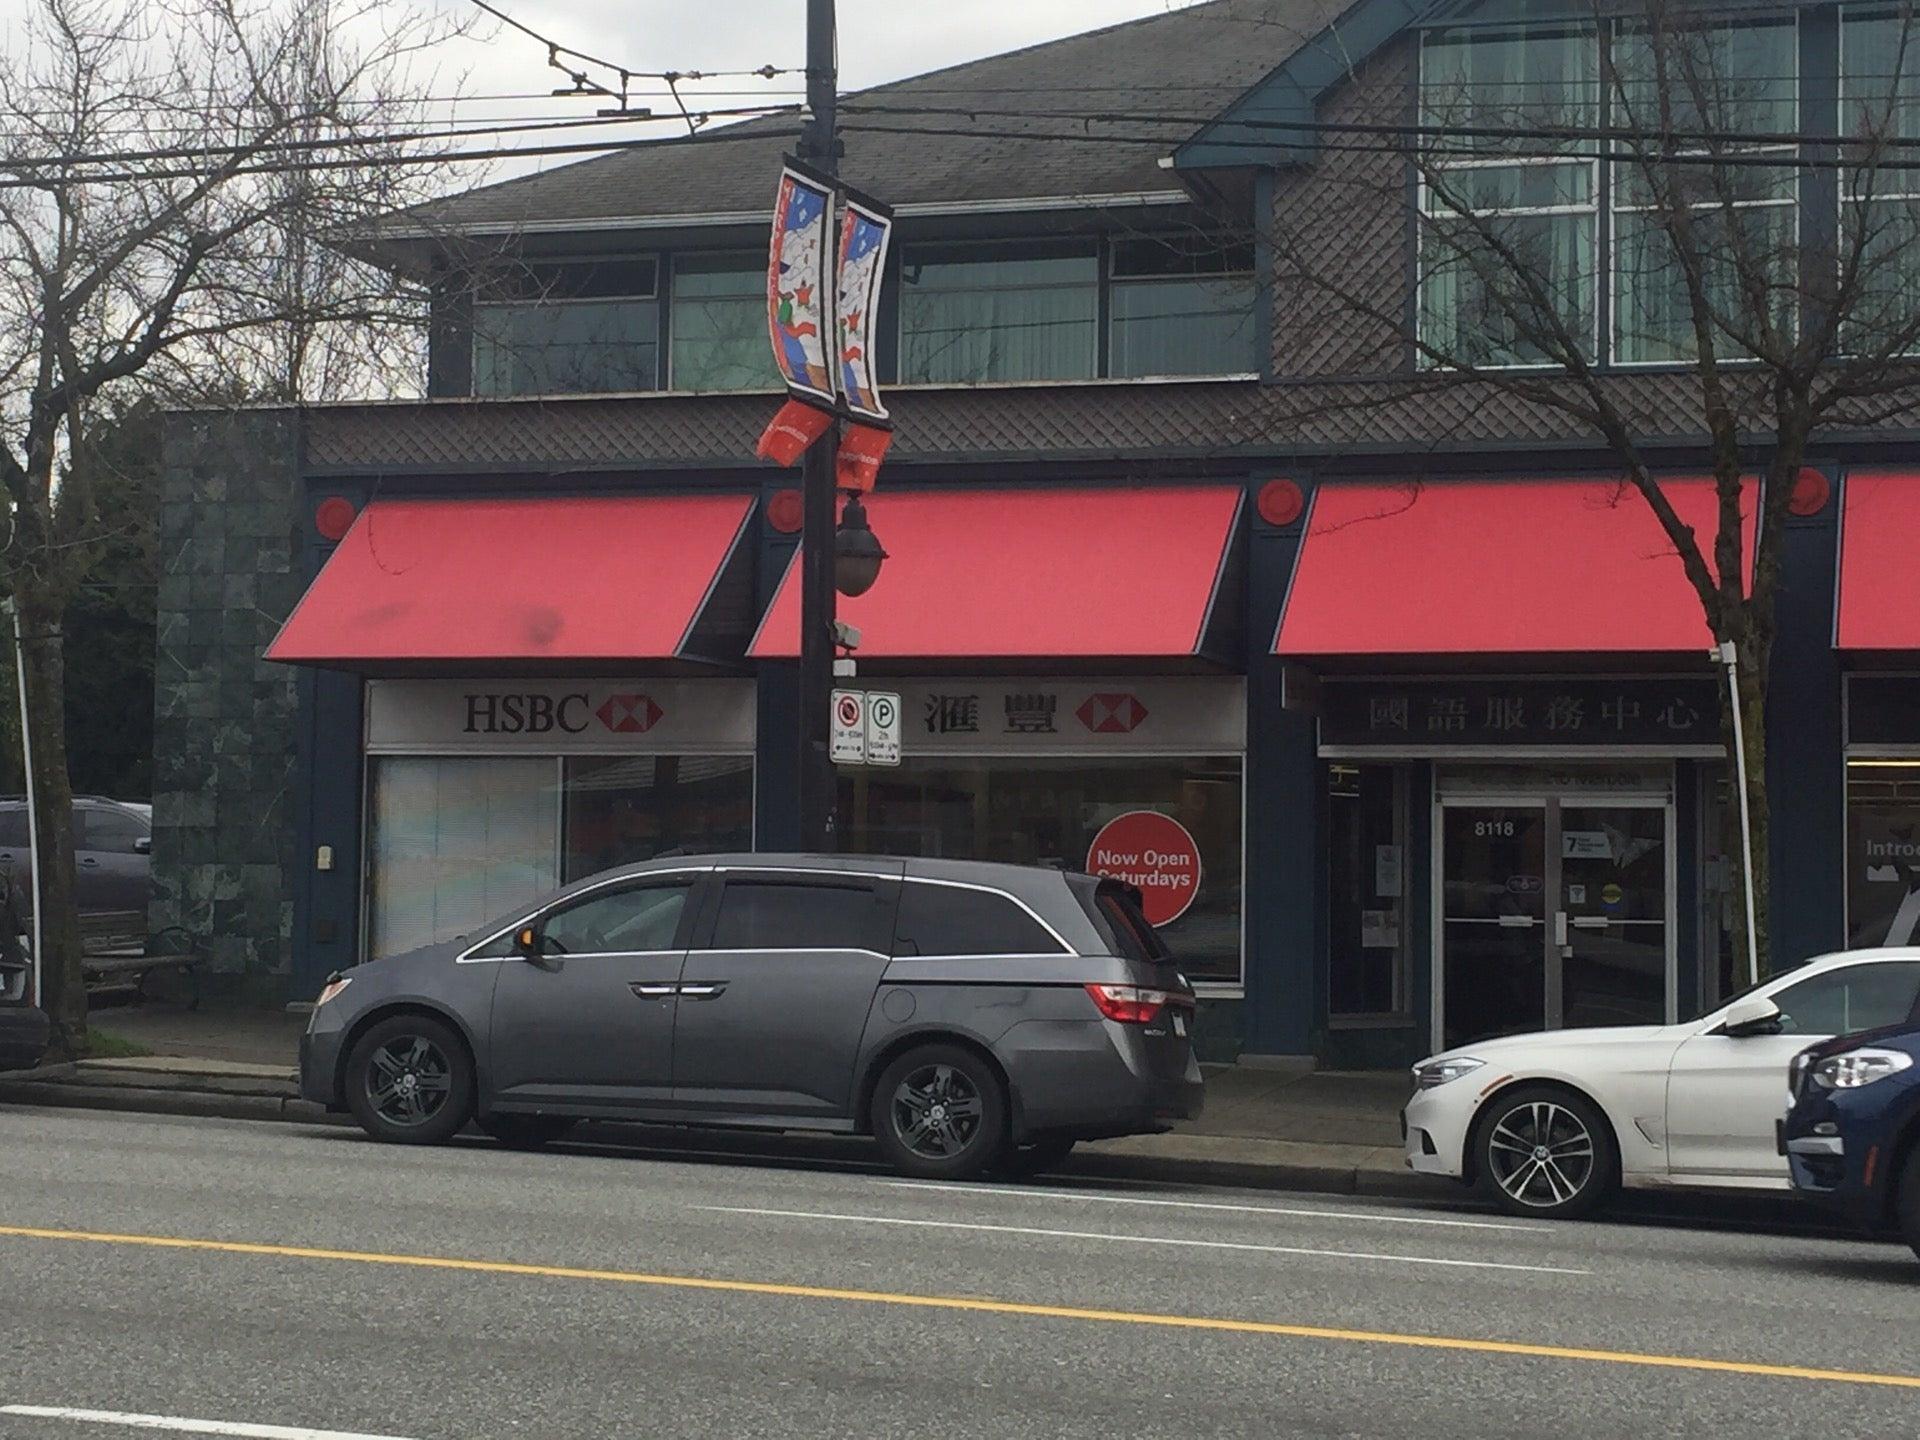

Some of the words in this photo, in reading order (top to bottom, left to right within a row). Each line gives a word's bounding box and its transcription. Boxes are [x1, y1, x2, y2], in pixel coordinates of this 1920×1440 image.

[463, 694, 589, 733] HSBC
[1369, 695, 1700, 730] 國語服務中心
[1475, 821, 1515, 837] 8118
[1566, 836, 1577, 852] 7
[1097, 850, 1138, 866] Now
[1143, 850, 1190, 870] Open
